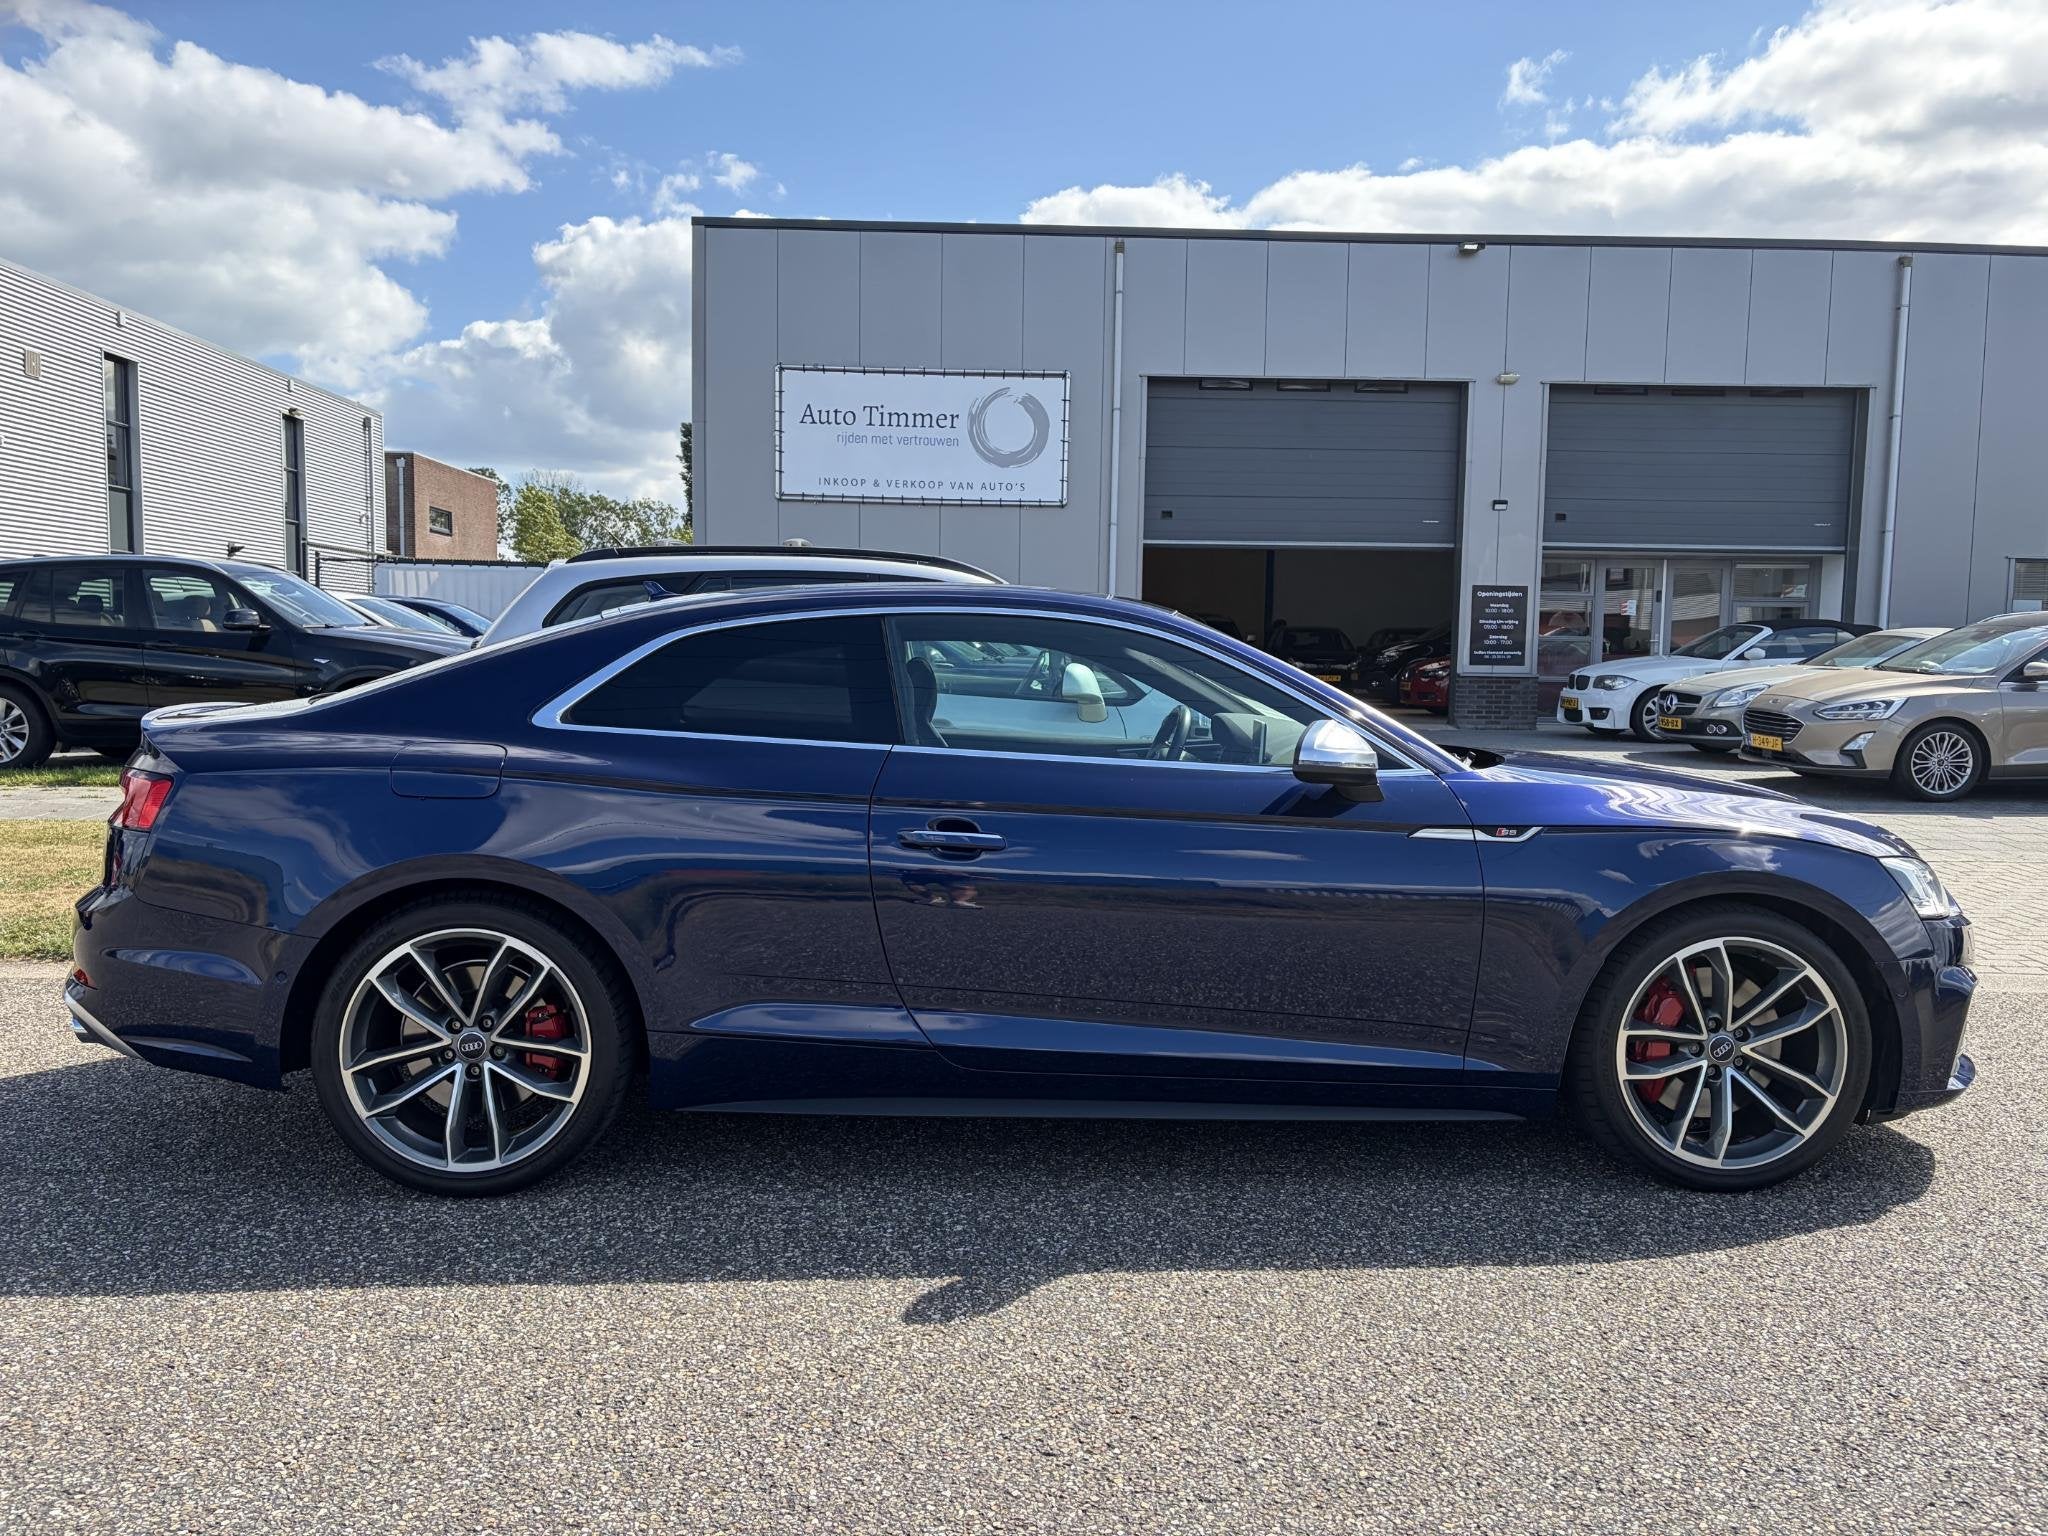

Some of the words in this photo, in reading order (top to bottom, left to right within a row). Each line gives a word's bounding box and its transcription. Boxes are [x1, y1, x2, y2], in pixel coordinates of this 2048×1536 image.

[800, 404, 856, 426] Auto
[863, 405, 960, 429] Timmer
[837, 432, 868, 448] rijden
[871, 434, 893, 446] met
[897, 435, 960, 447] vertrouwen
[818, 476, 867, 487] INKOOP
[873, 479, 880, 488] &
[886, 479, 944, 489] VERKOOP
[950, 480, 974, 490] VAN
